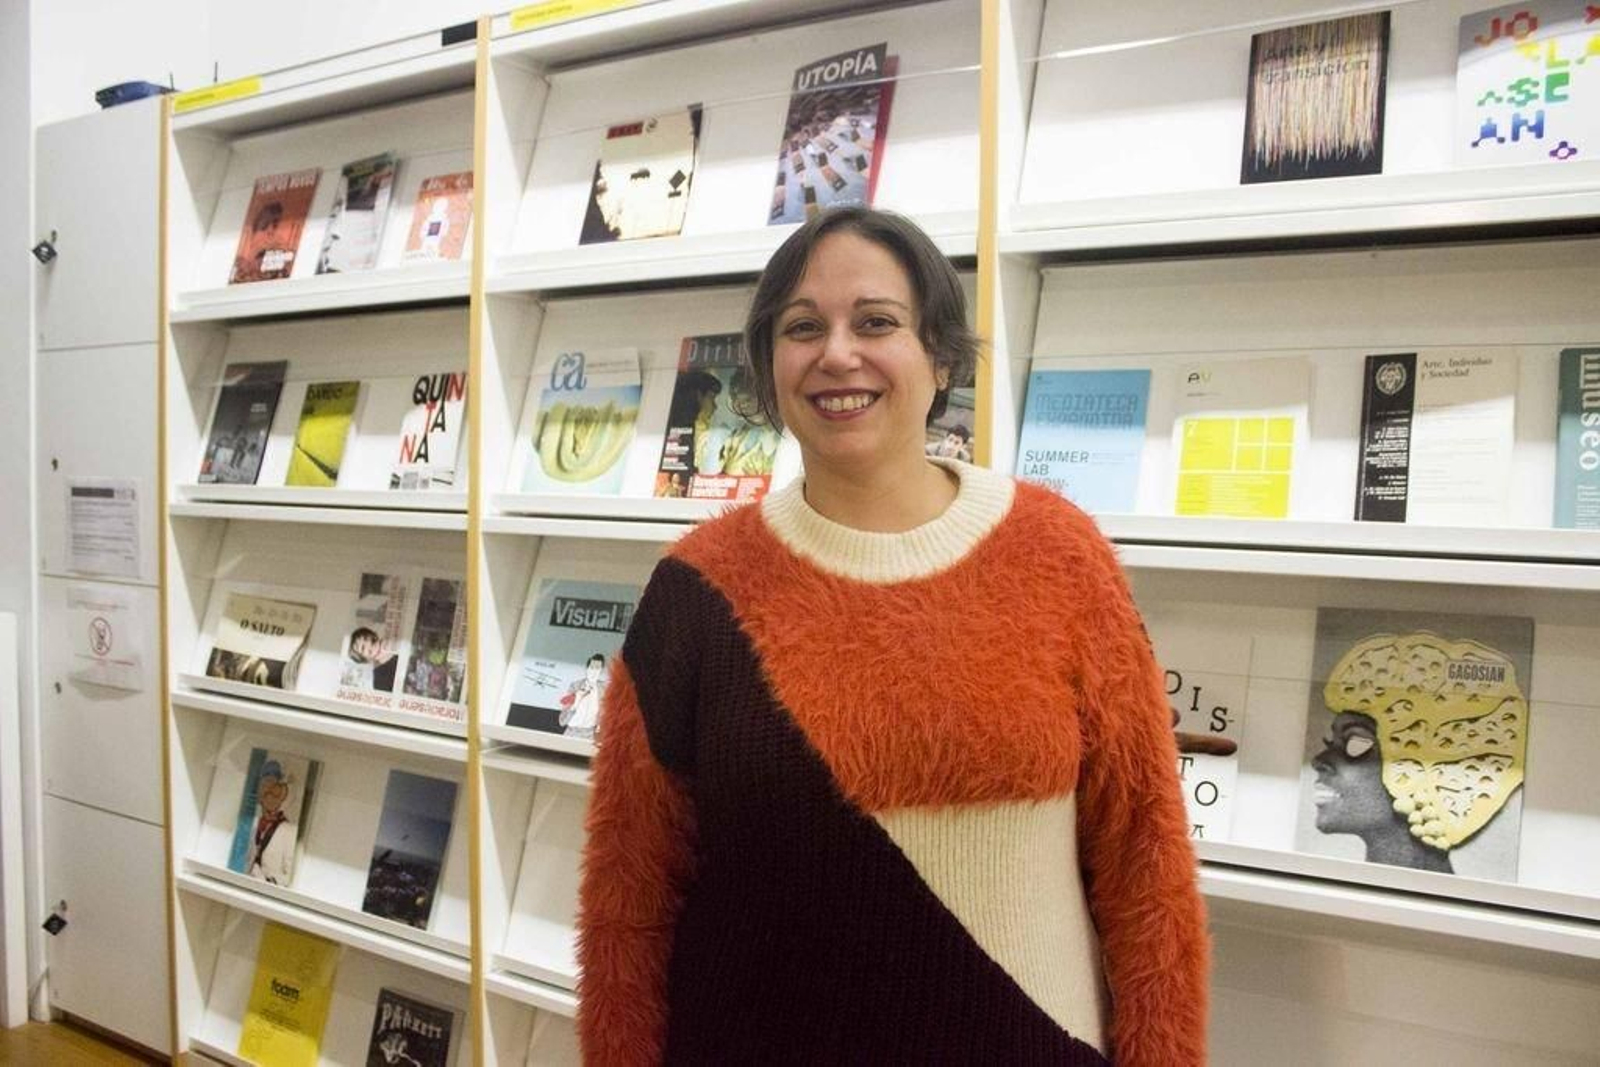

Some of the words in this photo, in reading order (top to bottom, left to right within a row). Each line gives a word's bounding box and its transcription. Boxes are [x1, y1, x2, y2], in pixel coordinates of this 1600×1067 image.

[798, 50, 878, 91] UTOPÍA
[1024, 449, 1090, 463] SUMMER
[1023, 463, 1050, 476] LAB
[554, 599, 618, 630] Visual
[1448, 662, 1506, 683] GAGOSIAN
